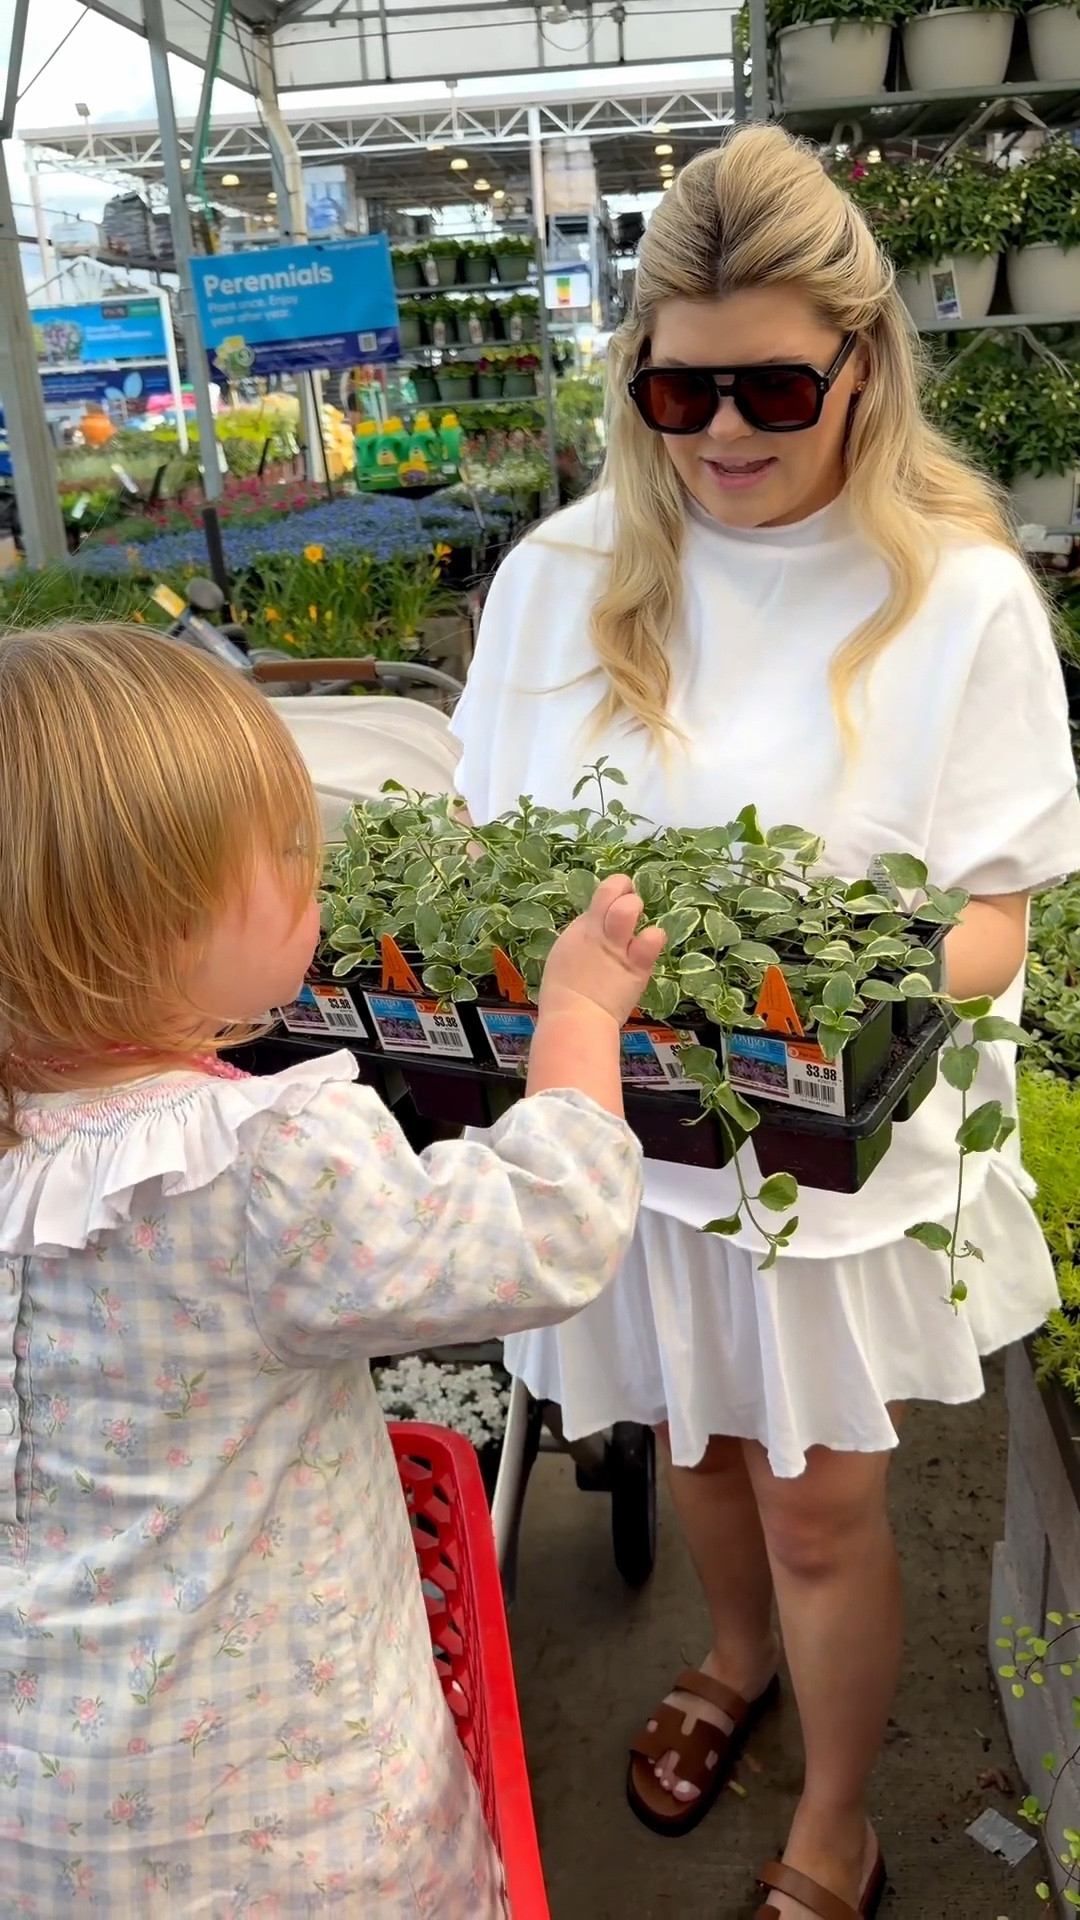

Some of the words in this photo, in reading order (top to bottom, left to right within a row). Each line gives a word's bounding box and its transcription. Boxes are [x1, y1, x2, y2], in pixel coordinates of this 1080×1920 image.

[203, 262, 333, 297] Perennials
[328, 998, 352, 1009] $3.98
[433, 1016, 458, 1027] $3.98
[806, 1064, 837, 1081] $3.98
